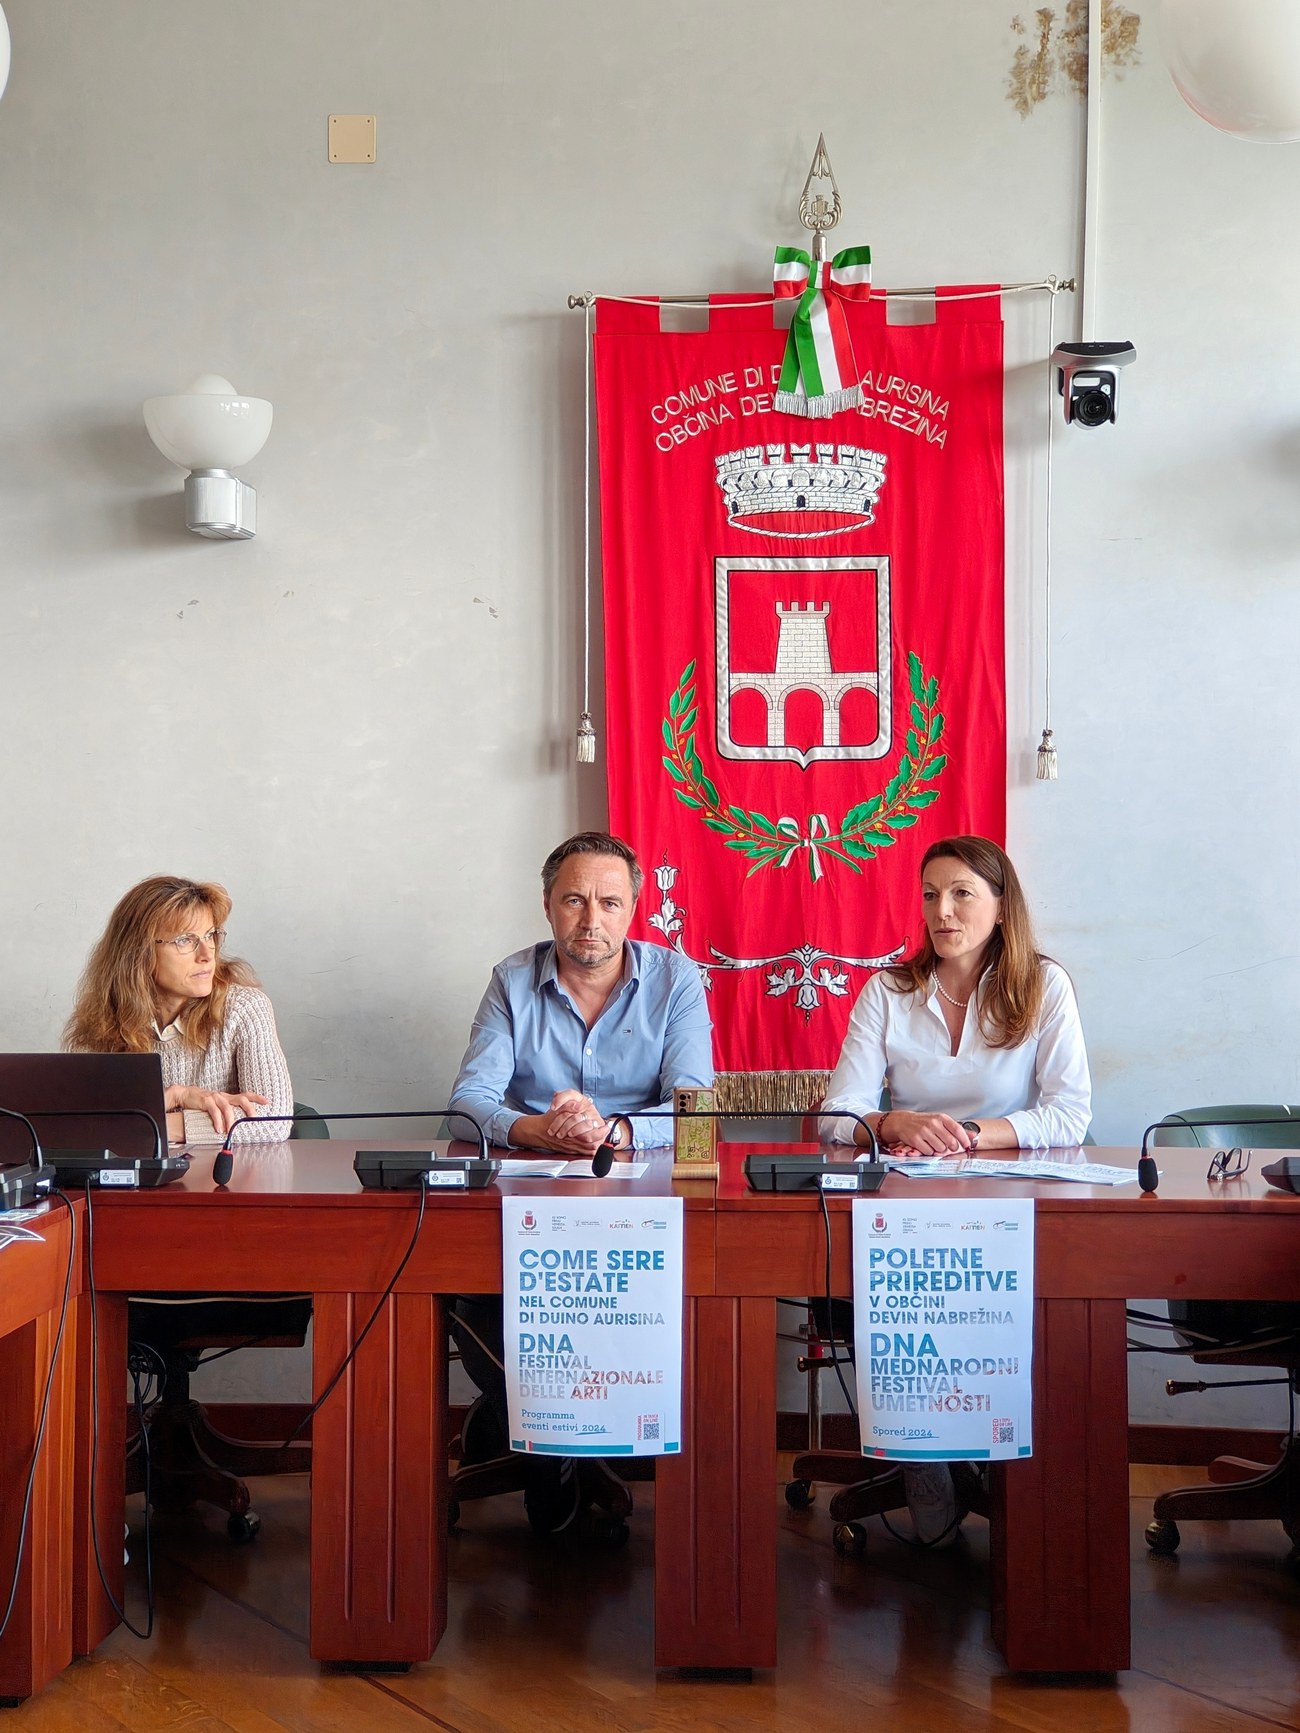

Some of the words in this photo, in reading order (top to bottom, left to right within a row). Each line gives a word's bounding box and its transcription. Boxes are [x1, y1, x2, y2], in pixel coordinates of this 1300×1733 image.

[651, 372, 738, 424] COMUNE
[743, 366, 764, 388] DI
[859, 370, 950, 422] AURISINA
[655, 403, 735, 452] OBČINA
[739, 392, 776, 416] DE
[856, 397, 948, 450] BREŽINA
[519, 1249, 598, 1270] COME
[606, 1250, 665, 1271] SERE
[869, 1248, 983, 1269] POLETNE
[519, 1272, 629, 1293] D'ESTATE
[869, 1270, 1018, 1292] PRIREDITVE
[519, 1296, 545, 1308] NEL
[550, 1296, 617, 1309] COMUNE
[869, 1295, 880, 1308] V
[886, 1292, 945, 1308] OBČINI
[519, 1312, 534, 1324] DI
[539, 1312, 589, 1325] DUINO
[593, 1313, 665, 1326] AURISINA
[869, 1312, 918, 1324] DEVIN
[924, 1308, 1015, 1325] NABREŽINA
[519, 1333, 574, 1354] DNA
[870, 1333, 939, 1357] DNA
[519, 1354, 592, 1370] FESTIVAL
[871, 1357, 1019, 1376] MEDNARODNI
[519, 1369, 664, 1385] INTERNAZIONALE
[872, 1376, 963, 1394] FESTIVAL
[519, 1384, 565, 1399] DELLE
[570, 1385, 608, 1400] ARTI
[872, 1394, 991, 1412] UMETNOSTI
[521, 1409, 575, 1420] Programma
[521, 1422, 549, 1431] eventi
[552, 1423, 578, 1432] estivi
[581, 1424, 606, 1433] 2024
[872, 1426, 906, 1437] Spored
[908, 1429, 933, 1437] 2024
